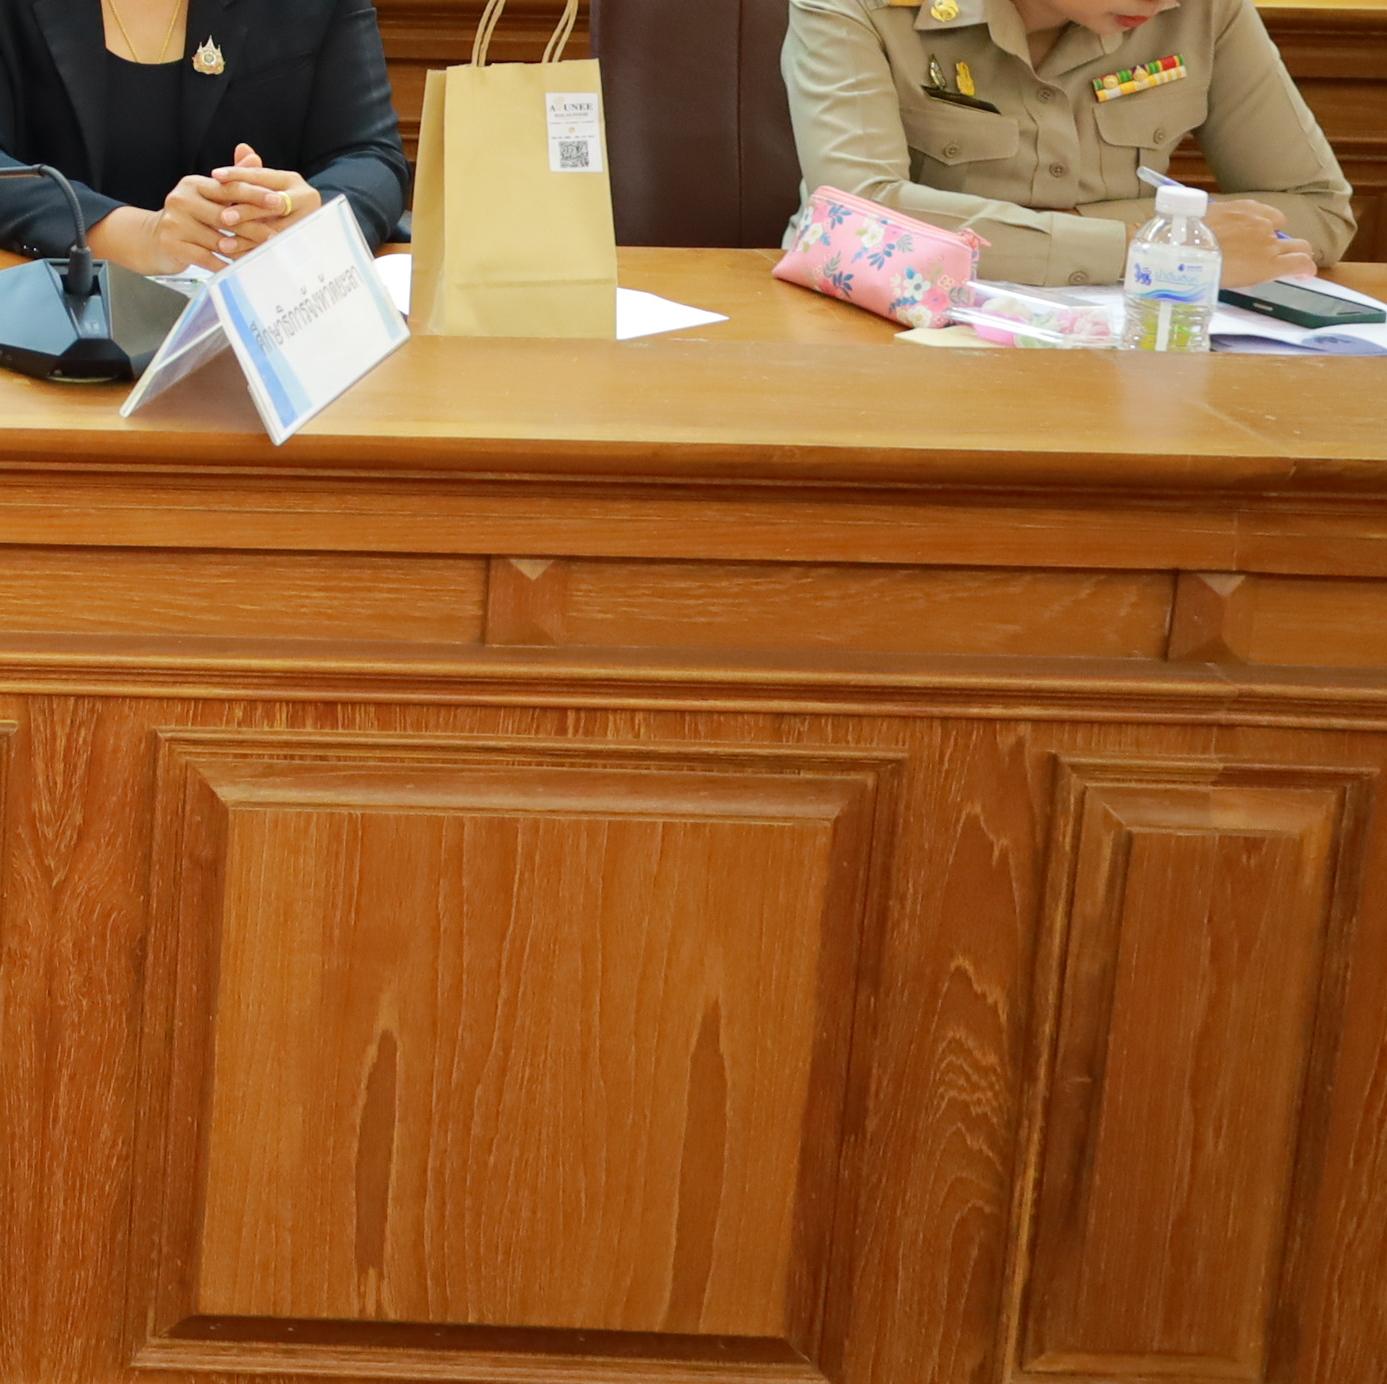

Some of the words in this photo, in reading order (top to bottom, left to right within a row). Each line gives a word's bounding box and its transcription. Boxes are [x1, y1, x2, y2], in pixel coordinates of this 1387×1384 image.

[249, 264, 365, 354] ศึกษาธิการจังหวัดยะลา
